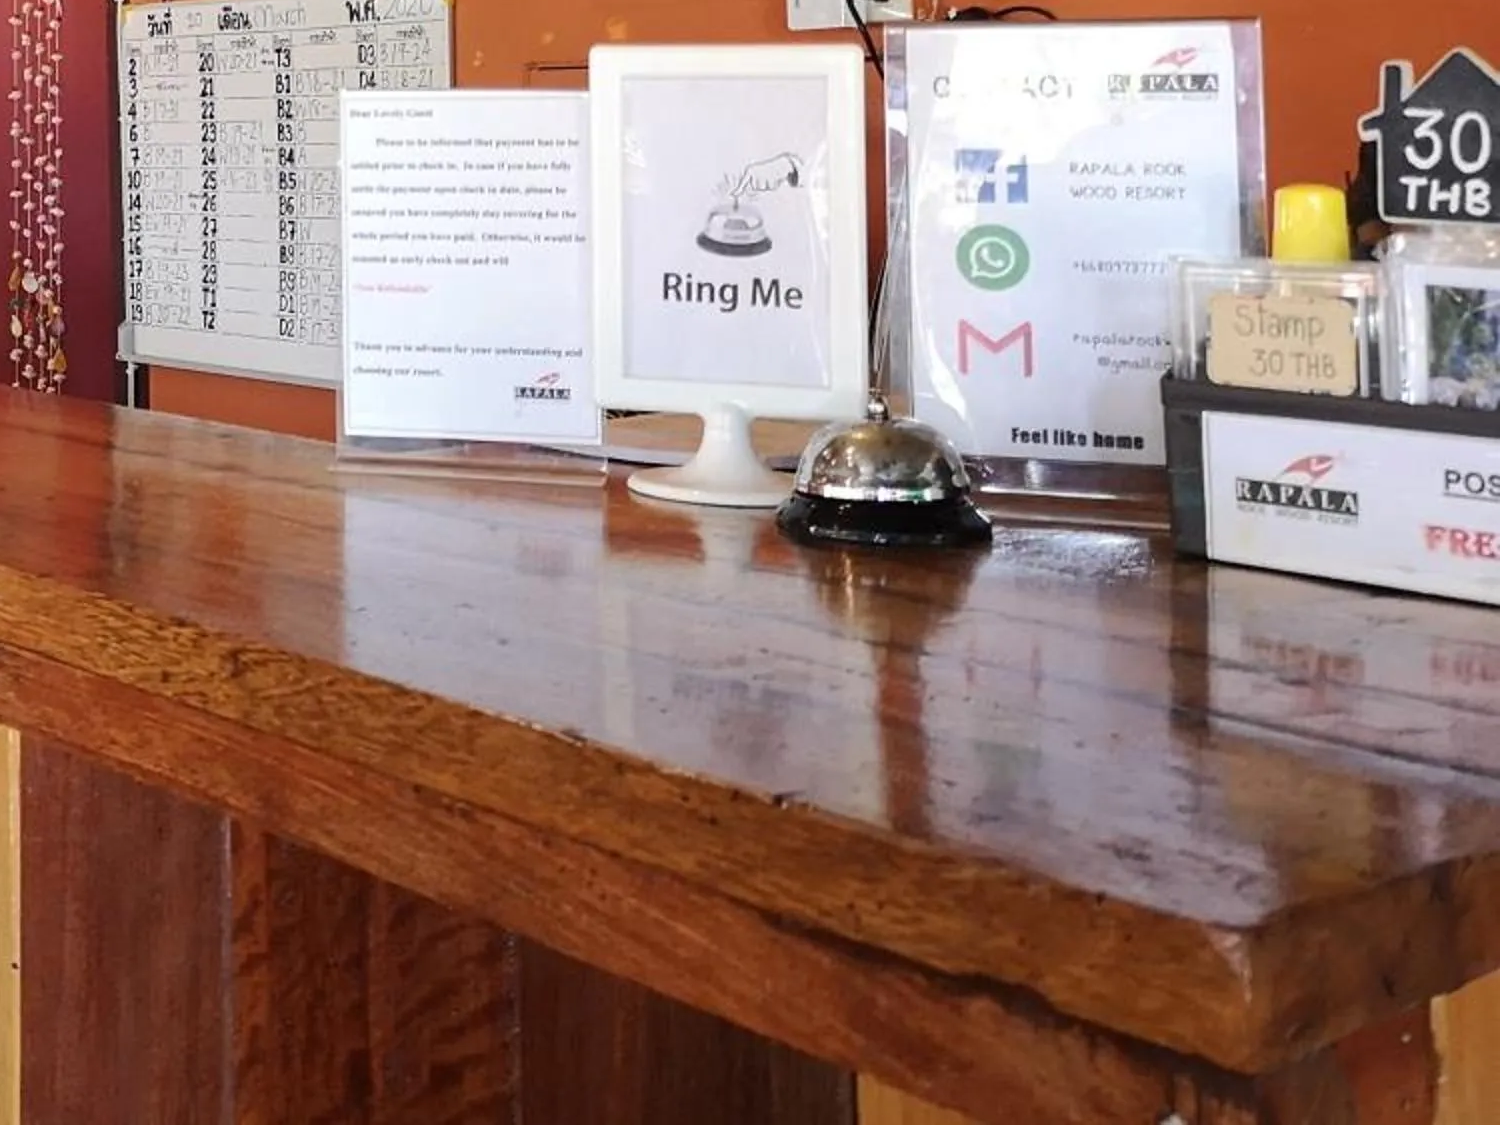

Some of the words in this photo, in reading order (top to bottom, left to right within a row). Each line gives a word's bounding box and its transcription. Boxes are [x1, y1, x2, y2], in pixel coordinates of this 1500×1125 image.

[198, 52, 215, 72] 20
[275, 48, 291, 68] T3
[357, 44, 376, 66] D3
[128, 58, 137, 76] 2
[129, 78, 138, 98] 3
[200, 77, 214, 98] 21
[275, 74, 291, 94] B1
[128, 102, 137, 121] 4
[200, 101, 215, 120] 22
[276, 99, 293, 120] B2
[129, 124, 139, 142] 6
[201, 123, 217, 143] 23
[277, 123, 293, 142] B3
[1403, 107, 1492, 174] 30
[130, 148, 140, 166] 7
[201, 147, 217, 166] 24
[278, 147, 295, 166] B4
[128, 170, 142, 189] 10
[202, 170, 217, 190] 25
[278, 170, 297, 190] B5
[129, 192, 142, 212] 14
[201, 192, 217, 212] 26
[1068, 186, 1117, 201] WOOD
[1399, 176, 1493, 217] THB
[278, 194, 295, 216] B6
[129, 215, 142, 233] 15
[202, 216, 217, 237] 27
[278, 218, 296, 241] B7
[129, 236, 142, 256] 16
[202, 240, 217, 261] 28
[129, 260, 143, 278] 17
[202, 264, 217, 284] 29
[279, 270, 297, 292] B9
[129, 282, 142, 302] 18
[201, 287, 217, 308] T1
[662, 271, 739, 312] Ring
[750, 277, 803, 309] Me
[131, 304, 143, 322] 19
[279, 294, 296, 314] D1
[201, 310, 216, 330] T2
[279, 318, 295, 338] D2
[1234, 300, 1325, 347] Stamp
[1249, 348, 1284, 376] 30
[1291, 352, 1337, 379] THB
[1011, 427, 1048, 445] Feel
[1053, 429, 1087, 447] like
[1092, 431, 1145, 450] home
[1236, 478, 1359, 515] RAPALA
[1425, 525, 1500, 559] FRE
